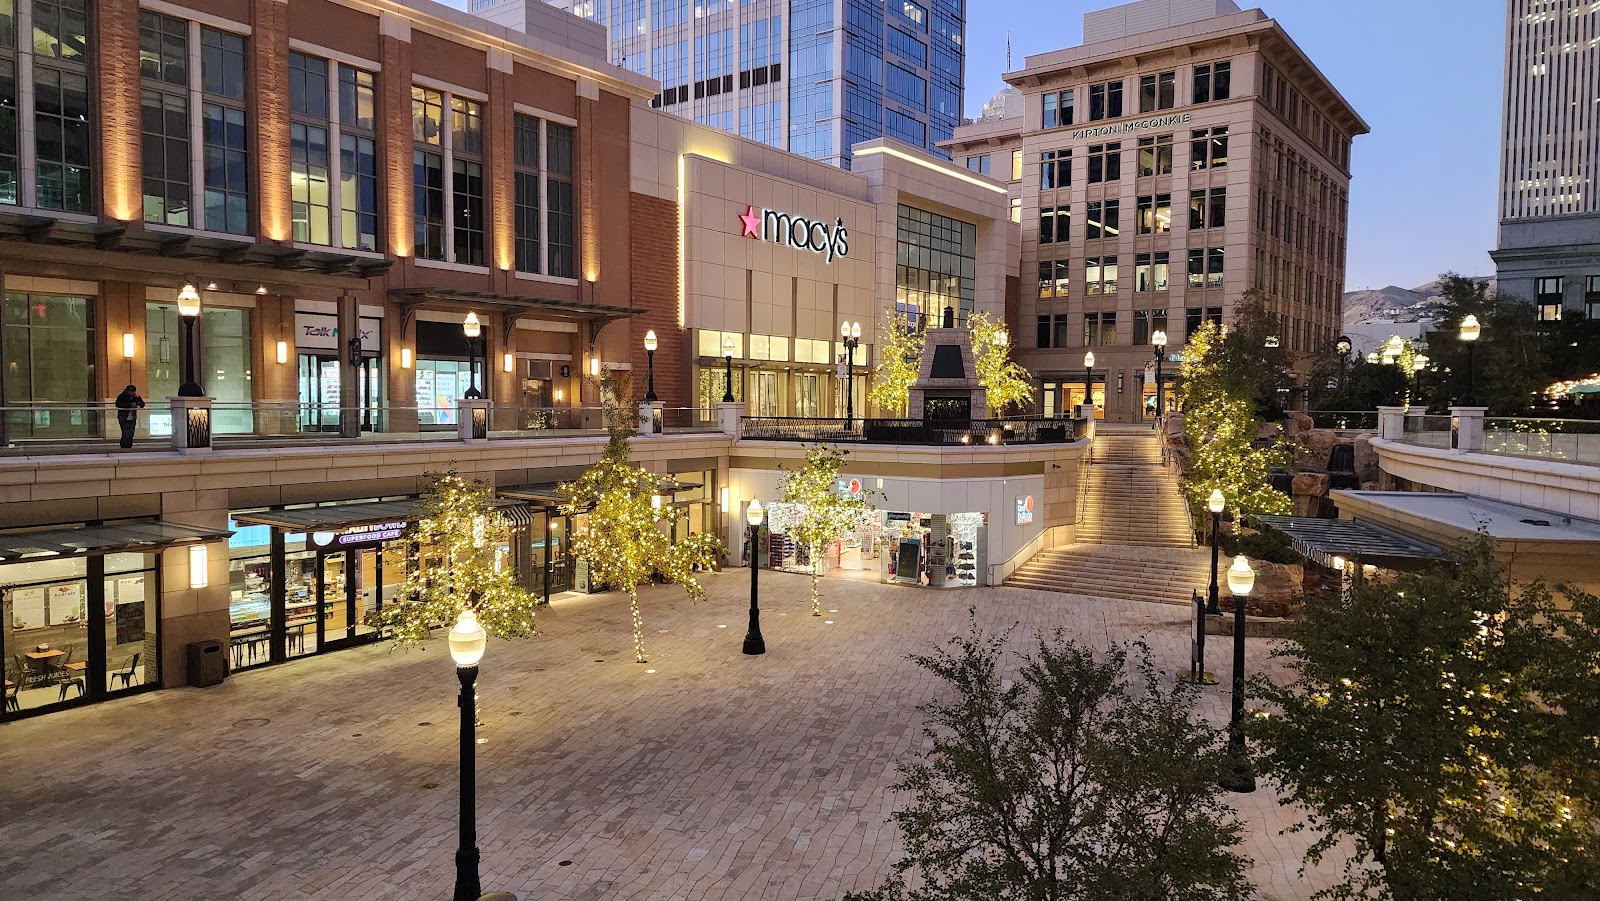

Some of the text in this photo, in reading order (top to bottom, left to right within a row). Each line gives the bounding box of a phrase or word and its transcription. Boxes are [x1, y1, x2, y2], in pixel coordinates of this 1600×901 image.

[1072, 124, 1119, 140] KIRTON
[303, 325, 331, 337] Talk
[342, 533, 381, 542] SUPERFOOD
[25, 670, 70, 684] FRESH JUICES
